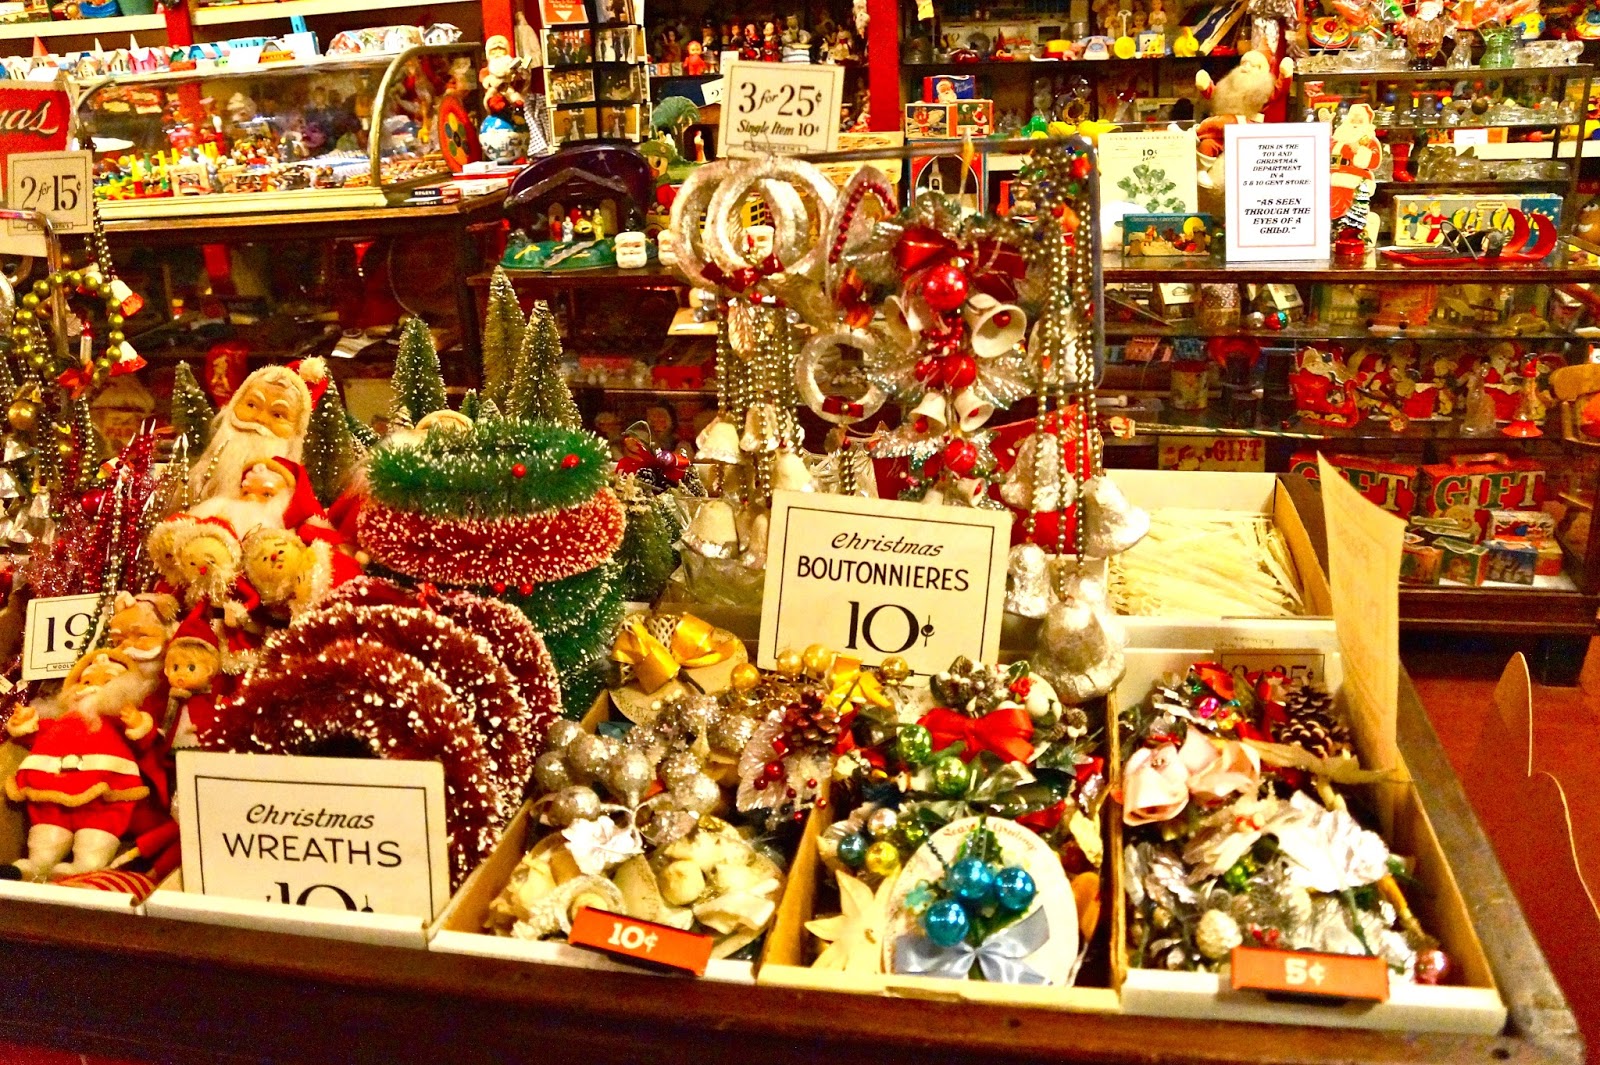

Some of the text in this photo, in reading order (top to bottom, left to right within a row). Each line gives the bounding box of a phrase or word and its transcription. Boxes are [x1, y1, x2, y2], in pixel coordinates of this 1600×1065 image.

[738, 81, 822, 118] 3 for 25¢
[737, 119, 820, 139] Single Item 10¢
[20, 175, 82, 212] 2 for 15¢
[1212, 440, 1261, 462] GIFT
[1290, 461, 1408, 511] GFT
[1434, 471, 1546, 511] GIFT
[831, 532, 944, 557] Christmas
[797, 555, 970, 592] BOUTONNIERES
[845, 600, 936, 654] 10¢
[246, 804, 375, 830] Christmas
[222, 832, 402, 868] WREATHS
[608, 922, 658, 952] 10¢
[1284, 958, 1325, 986] 5¢
